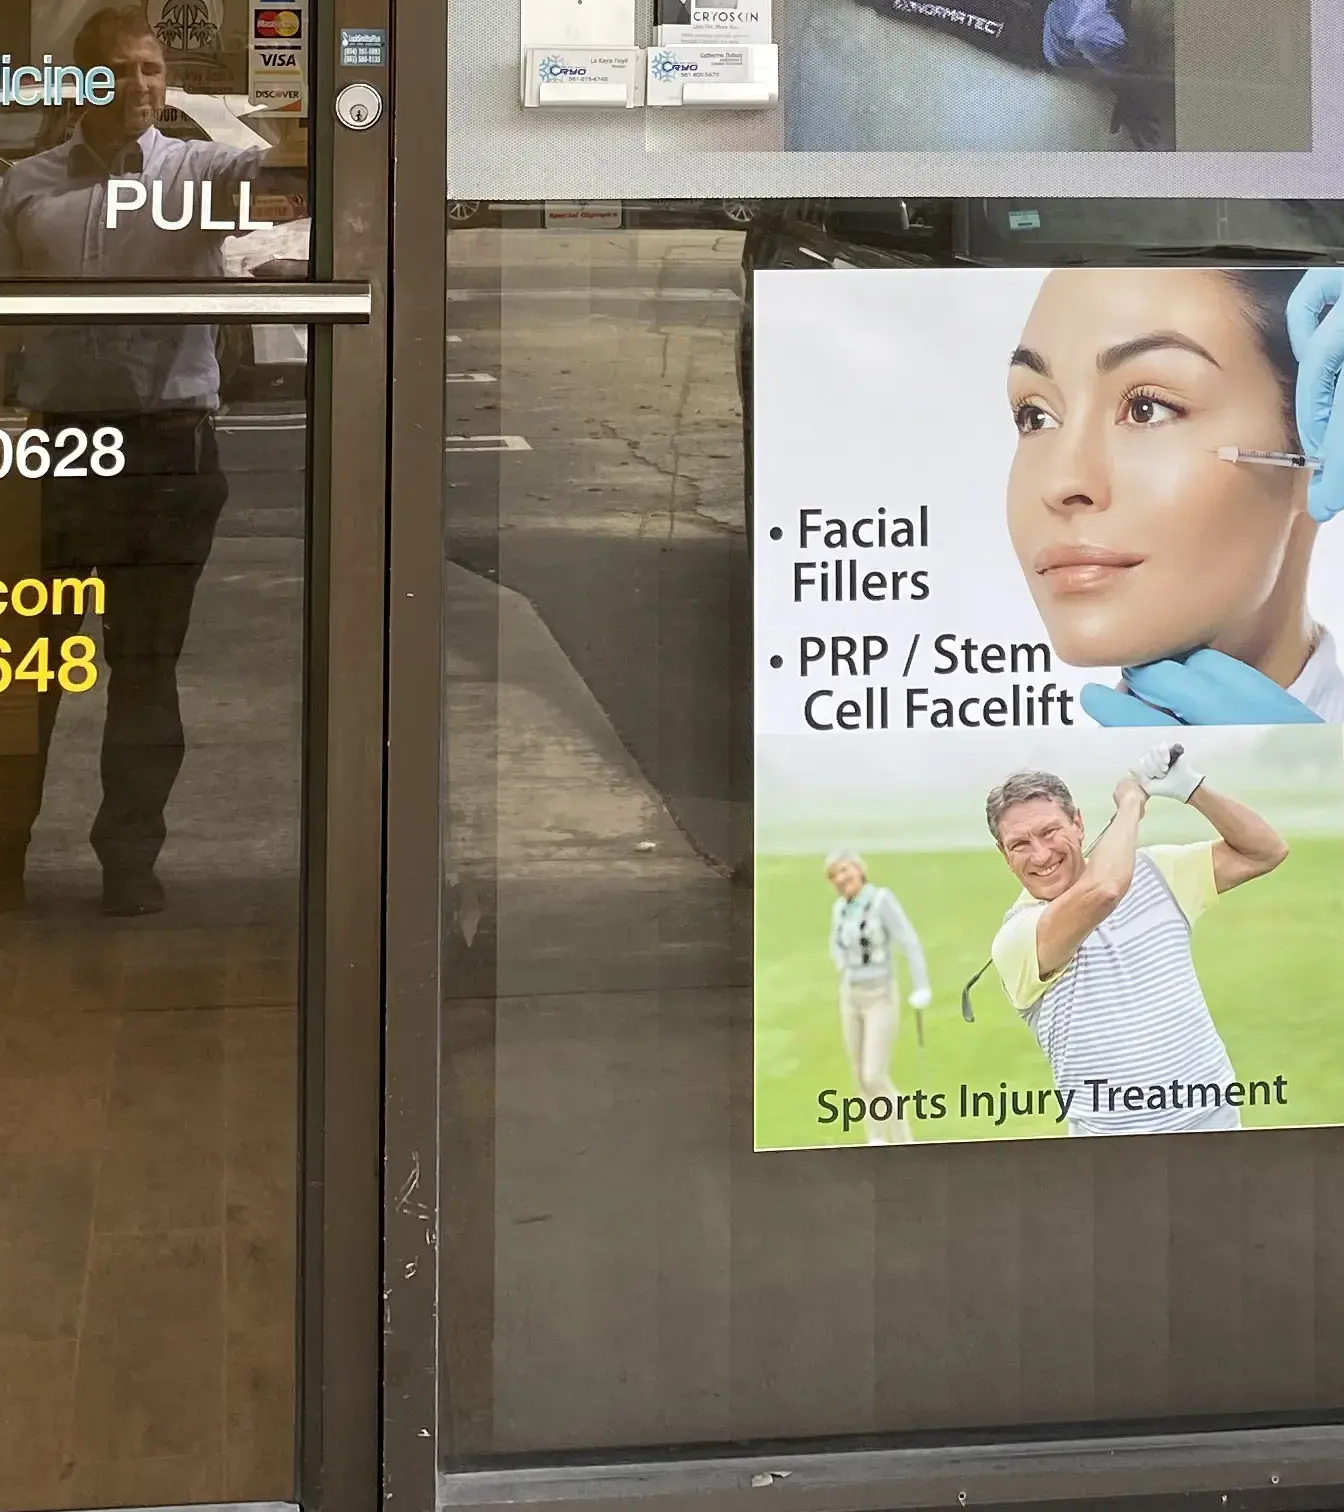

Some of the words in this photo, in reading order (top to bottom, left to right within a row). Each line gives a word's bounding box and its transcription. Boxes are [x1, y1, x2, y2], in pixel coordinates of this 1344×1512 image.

[693, 12, 758, 22] CRYOSKIN
[260, 54, 296, 67] VISA
[256, 90, 299, 98] DISCOVER
[106, 179, 273, 230] PULL
[799, 505, 928, 548] Facial
[793, 559, 930, 602] Fillers
[800, 636, 889, 676] PRP
[934, 634, 1051, 674] Stem
[804, 687, 889, 730] Cell
[906, 684, 1074, 728] Facelift
[817, 1088, 947, 1132] Sports
[960, 1082, 1076, 1127] Injury
[1084, 1075, 1288, 1113] Treatment
